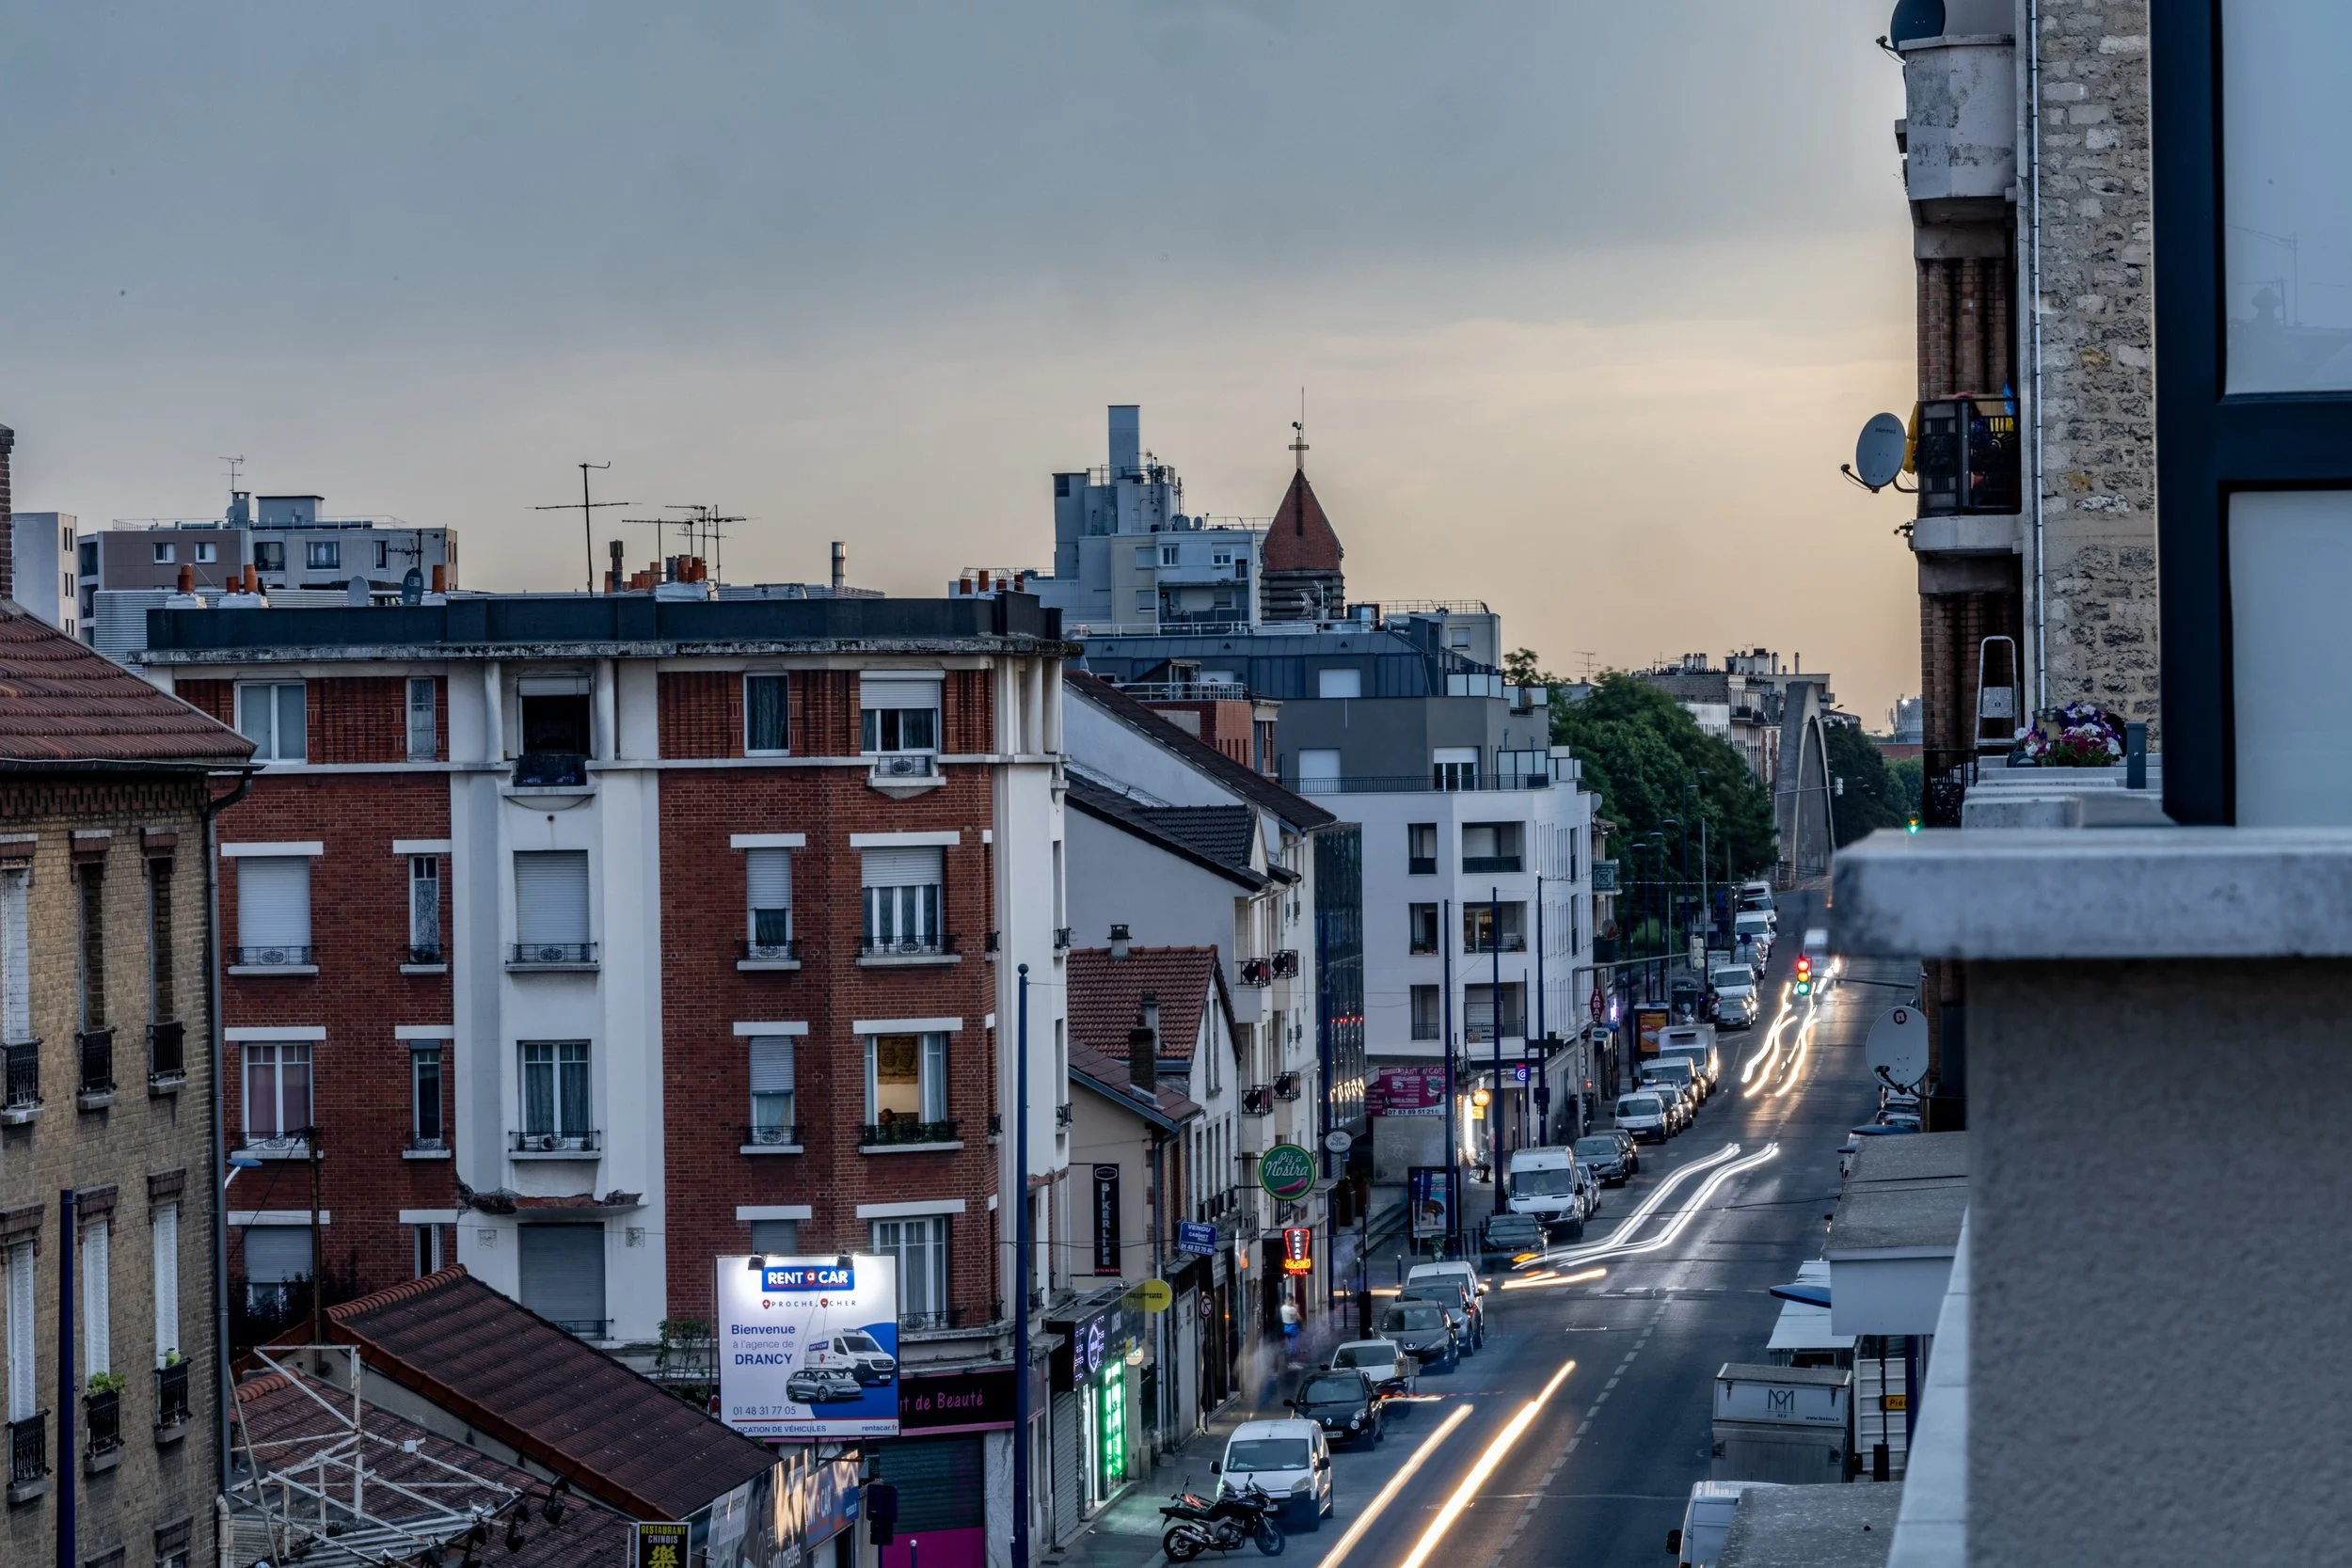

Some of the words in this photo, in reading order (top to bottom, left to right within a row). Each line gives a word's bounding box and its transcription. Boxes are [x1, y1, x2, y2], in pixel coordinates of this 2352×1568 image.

[1265, 1161, 1309, 1177] Nostra
[1187, 1224, 1211, 1232] VENDU
[768, 1272, 803, 1284] RENT
[818, 1271, 848, 1284] CAR
[731, 1324, 796, 1335] Bienvenue
[733, 1340, 739, 1349] à
[740, 1339, 783, 1351] l'agence
[784, 1339, 794, 1349] de
[735, 1354, 793, 1365] DRANCY
[915, 1394, 931, 1411] de
[937, 1388, 984, 1409] Beauté
[733, 1407, 742, 1416] 01
[745, 1406, 756, 1416] 48
[759, 1406, 769, 1416] 31
[771, 1406, 783, 1415] 77
[785, 1406, 796, 1415] 05
[771, 1425, 783, 1433] DE
[785, 1423, 826, 1433] VÉHICULES
[641, 1525, 686, 1535] RESTAURANT
[648, 1534, 678, 1544] CHINOIS
